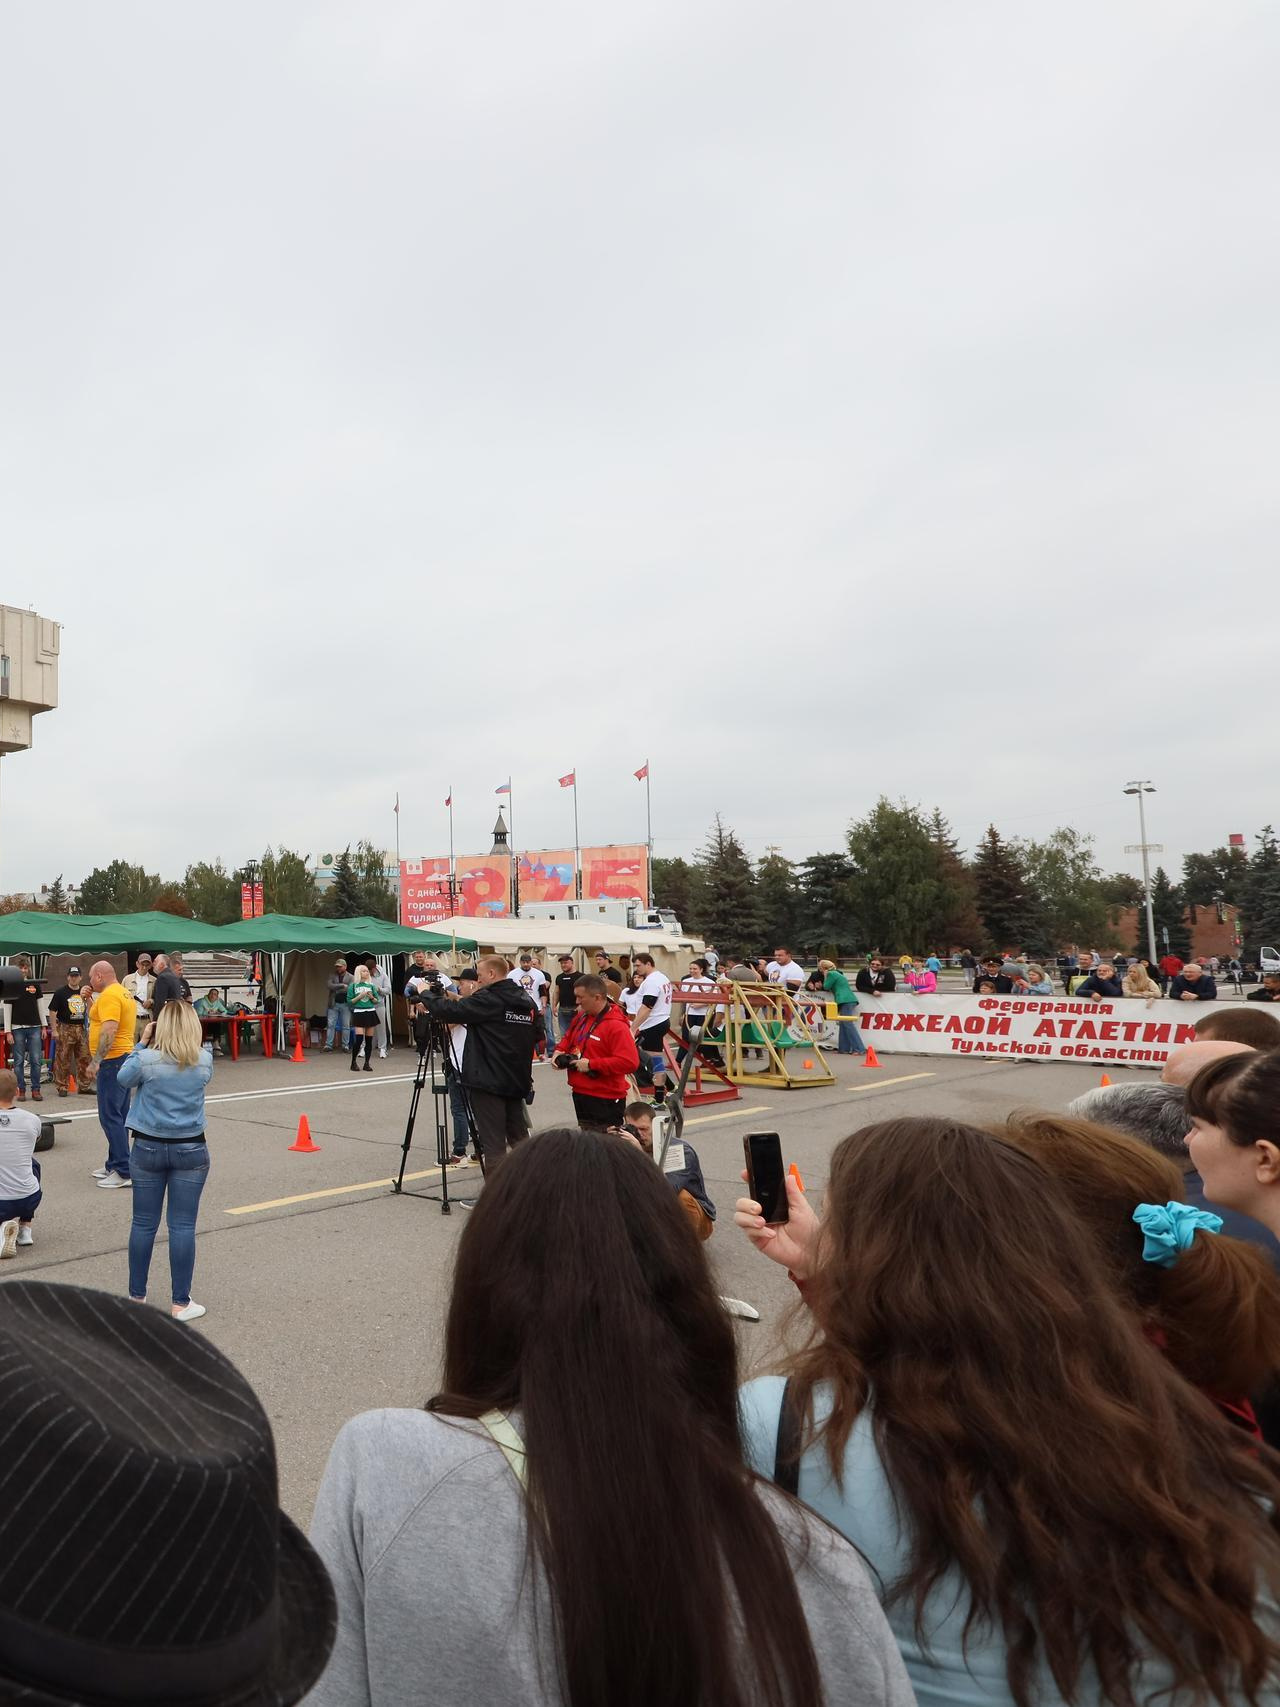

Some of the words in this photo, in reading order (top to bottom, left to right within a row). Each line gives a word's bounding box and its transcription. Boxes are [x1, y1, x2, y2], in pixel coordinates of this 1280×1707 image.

[408, 902, 445, 911] города,
[408, 913, 446, 923] туляки!
[979, 998, 1113, 1015] Федерация
[860, 1012, 1012, 1036] ТЯЖЕЛОЙ
[952, 1037, 1052, 1056] Тульской
[1060, 1044, 1169, 1063] области
